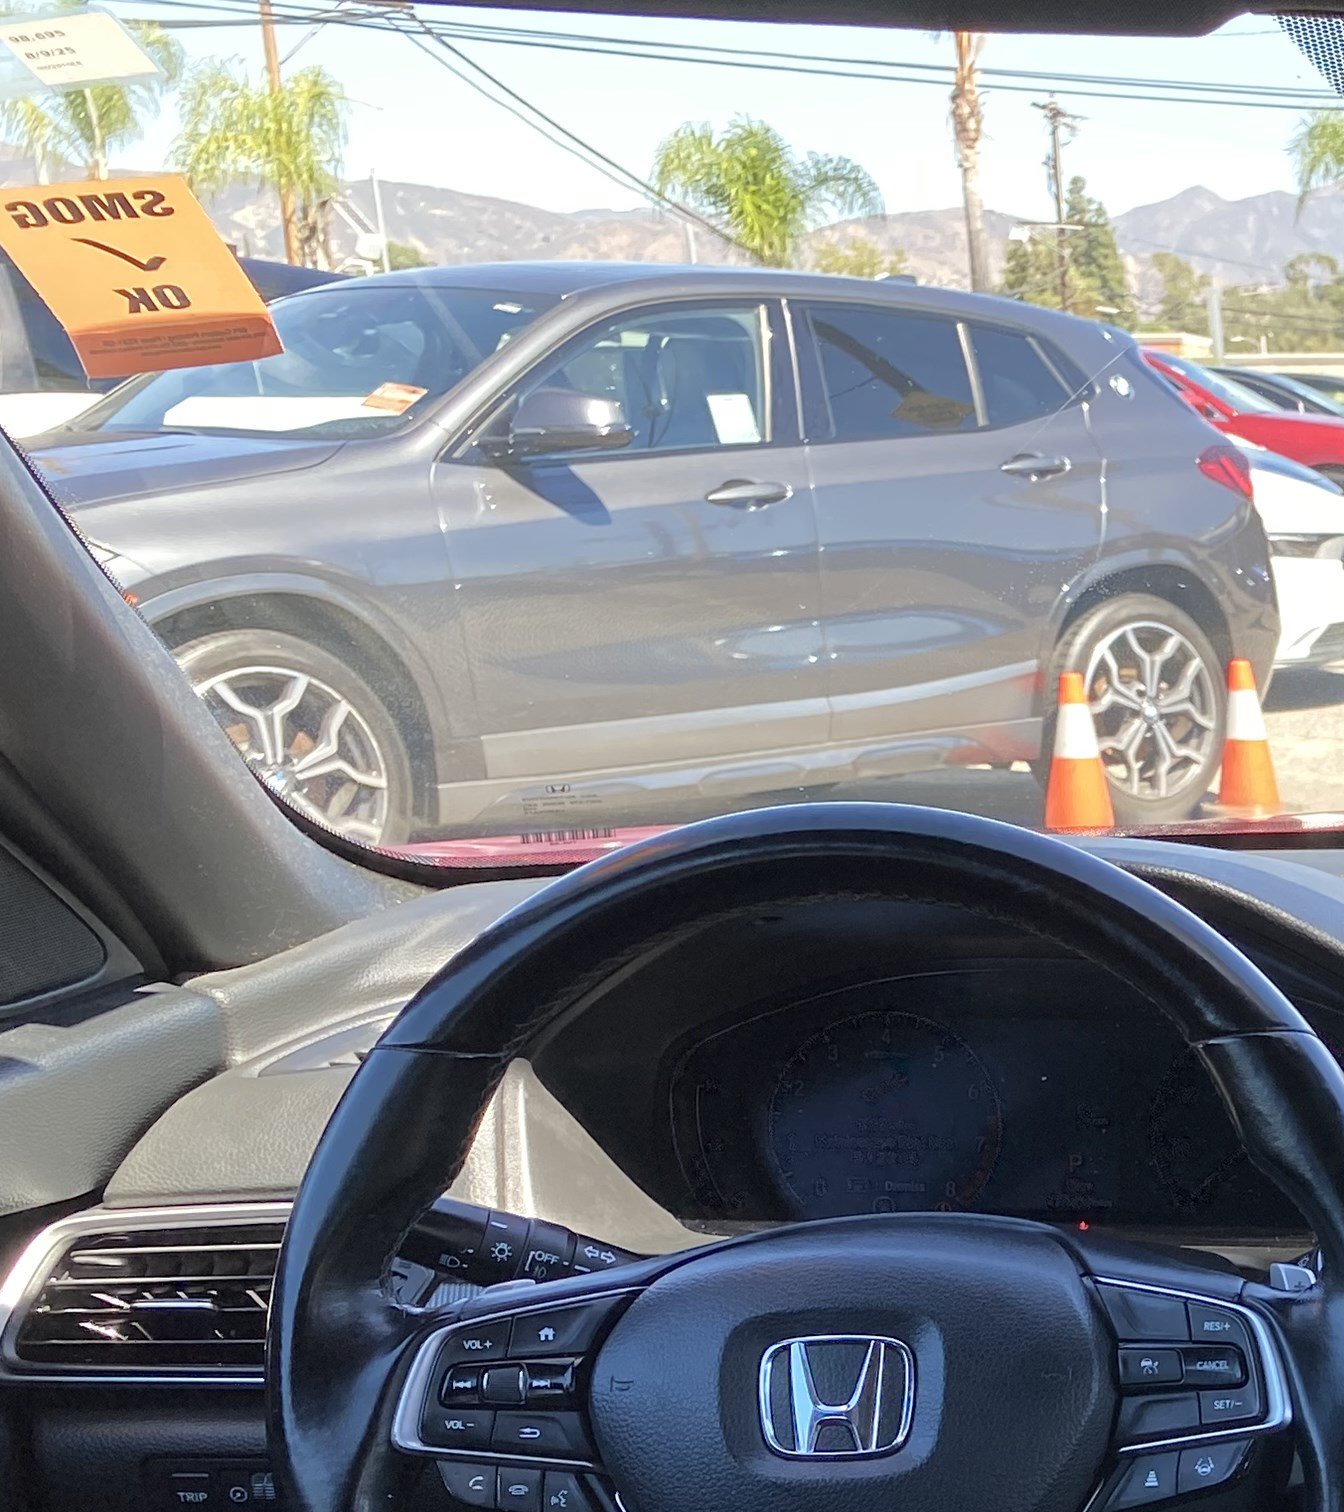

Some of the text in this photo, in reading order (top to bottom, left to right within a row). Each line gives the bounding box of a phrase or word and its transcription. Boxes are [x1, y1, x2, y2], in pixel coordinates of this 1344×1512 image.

[534, 1250, 560, 1264] OFF
[1196, 1360, 1229, 1370] CANCEL
[176, 1491, 208, 1503] TRIP
